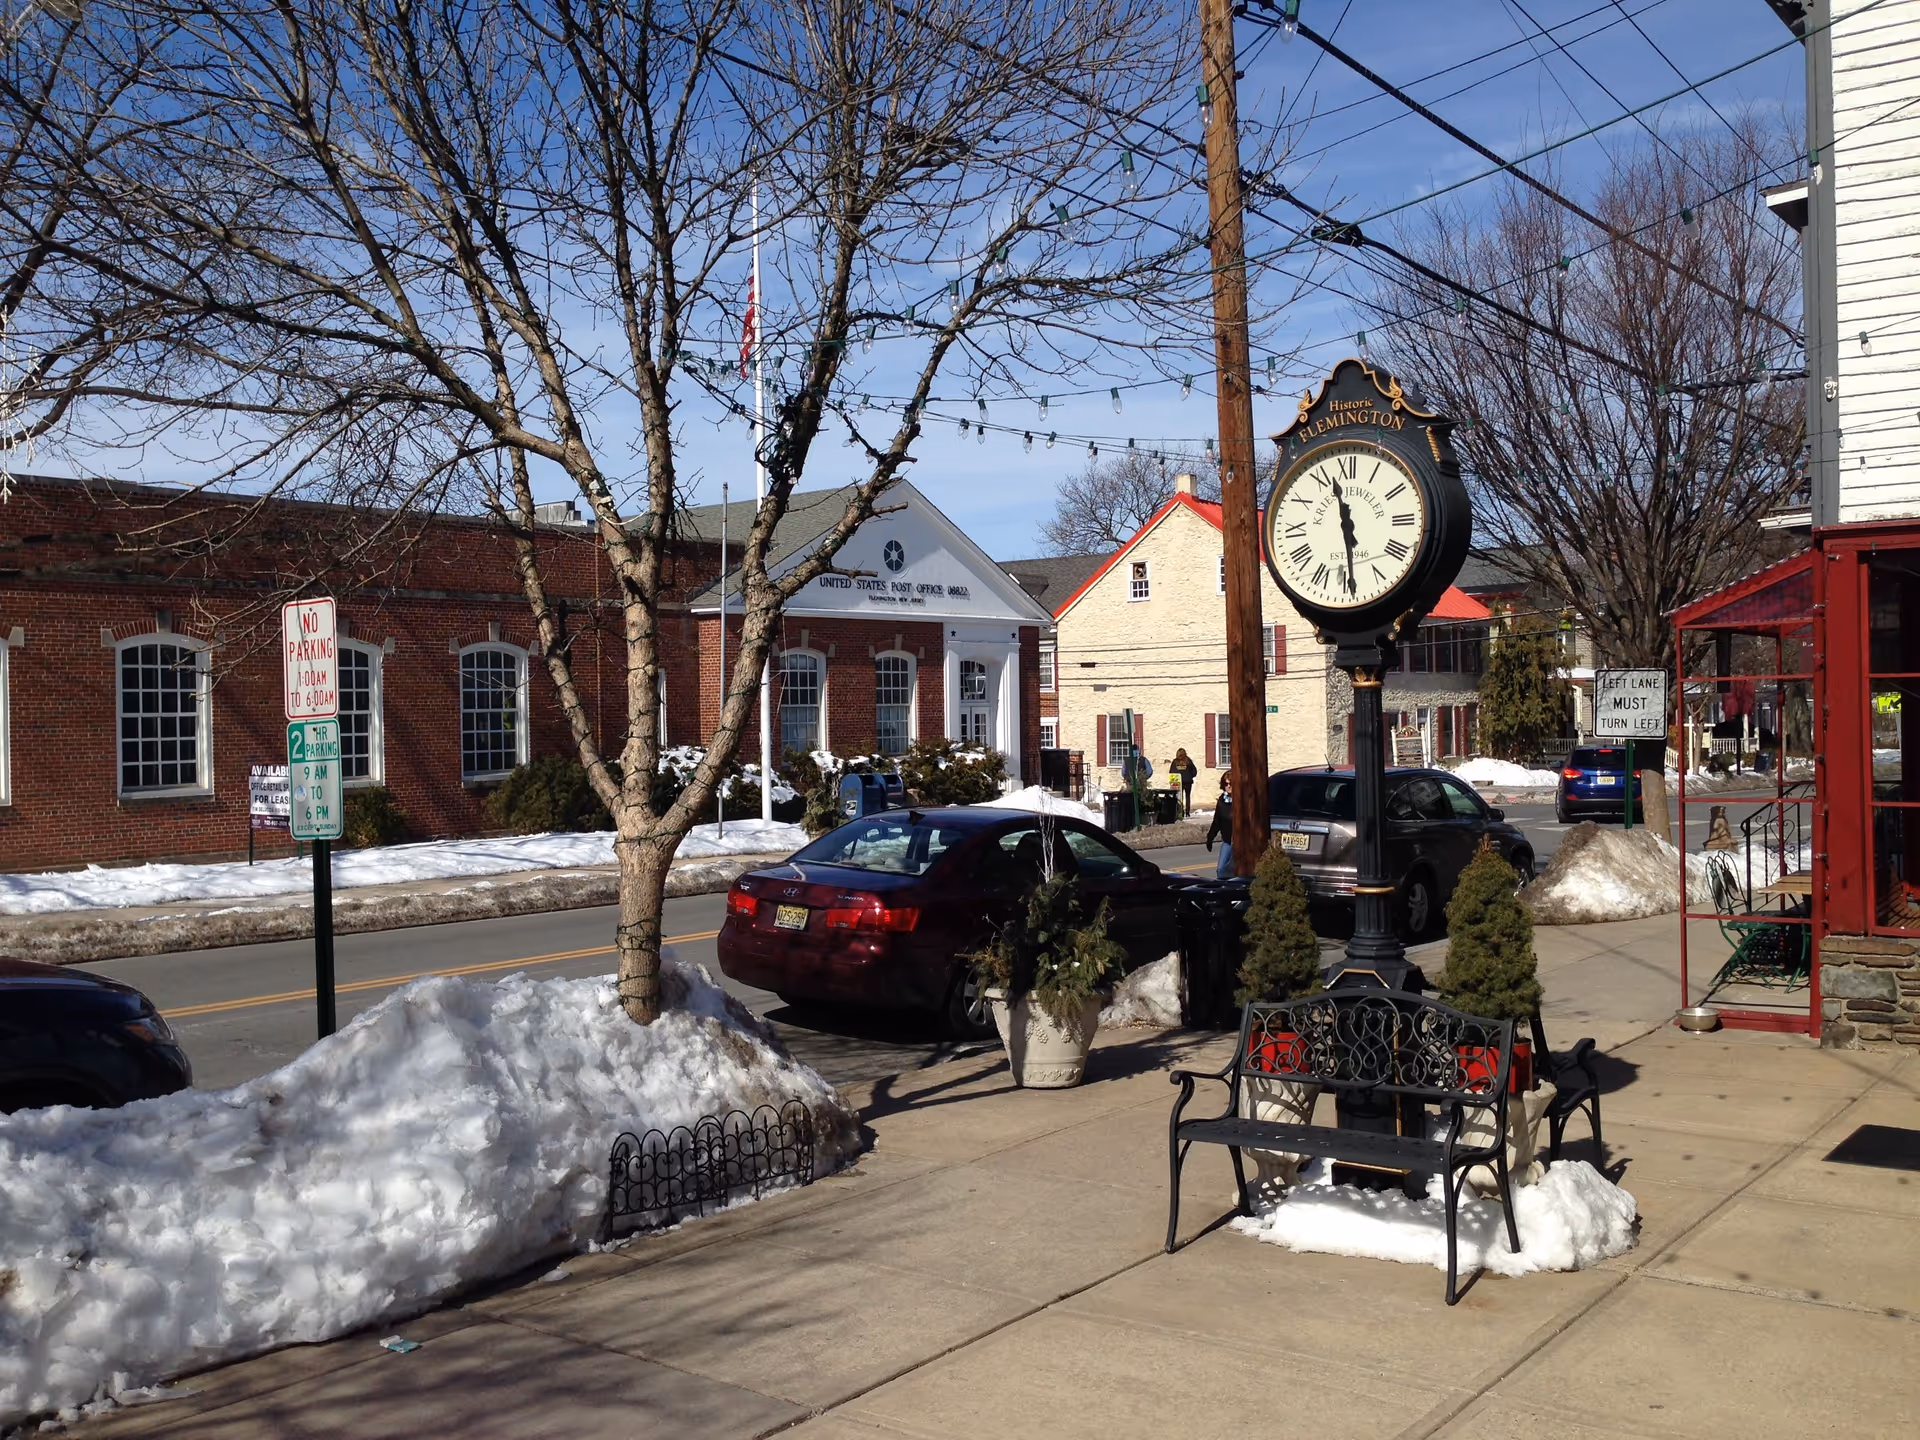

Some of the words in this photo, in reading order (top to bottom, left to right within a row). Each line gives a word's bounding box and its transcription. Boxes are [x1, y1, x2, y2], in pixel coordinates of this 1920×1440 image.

[1329, 396, 1374, 412] Historic
[1298, 410, 1406, 443] FLEMINGTON
[1344, 486, 1385, 519] JEWELER
[820, 577, 851, 589] UNITED
[856, 579, 886, 591] STATES
[891, 581, 912, 593] POST
[916, 584, 943, 595] OFFICE
[947, 586, 969, 596] 08822
[303, 612, 318, 634] NO
[289, 637, 333, 662] PARKING
[298, 670, 327, 687] 1:00AM
[1602, 678, 1627, 689] LEFT
[1631, 678, 1659, 689] LANE
[291, 692, 301, 708] TO
[306, 690, 334, 707] 6:00AM
[1613, 697, 1647, 710] MUST
[1601, 718, 1628, 729] TURN
[1634, 718, 1660, 729] LEFT
[315, 726, 327, 741] HR
[291, 730, 304, 759] 2
[305, 741, 337, 757] PARKING
[304, 766, 310, 780] 9
[314, 765, 327, 780] AM
[254, 795, 269, 804] FOR
[271, 795, 290, 805] LEAS
[311, 785, 323, 800] TO
[305, 806, 312, 820] 6
[316, 805, 329, 820] PM
